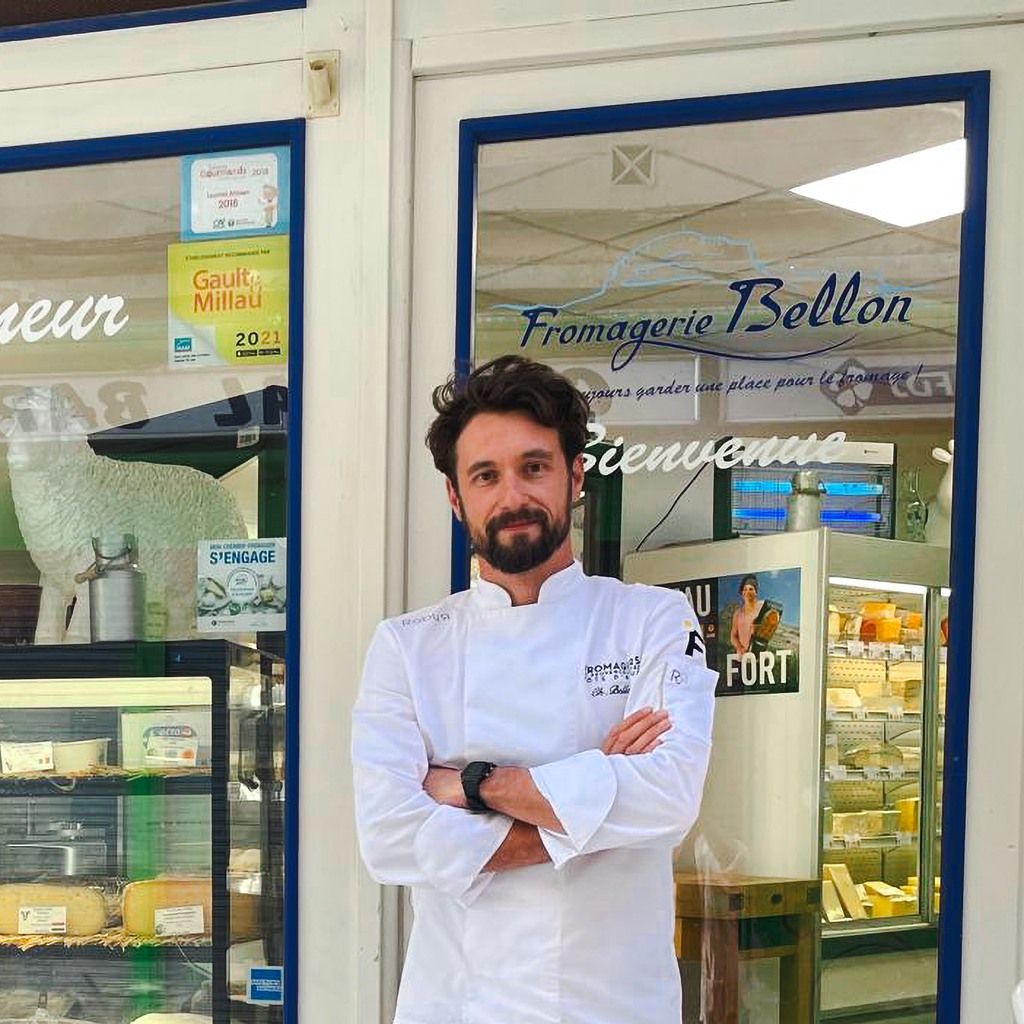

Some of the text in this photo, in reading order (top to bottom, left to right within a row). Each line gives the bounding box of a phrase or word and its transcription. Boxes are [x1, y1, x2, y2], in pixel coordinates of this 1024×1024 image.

[192, 268, 250, 291] Gault
[193, 291, 262, 313] Millau
[520, 271, 913, 371] Fromagerie Bellon
[236, 331, 281, 347] 2021
[636, 379, 691, 401] garder
[695, 381, 724, 393] une
[726, 375, 772, 397] place
[775, 374, 814, 392] pour
[820, 370, 834, 385] le
[209, 550, 276, 565] S'ENGAGE
[726, 650, 792, 688] FORT
